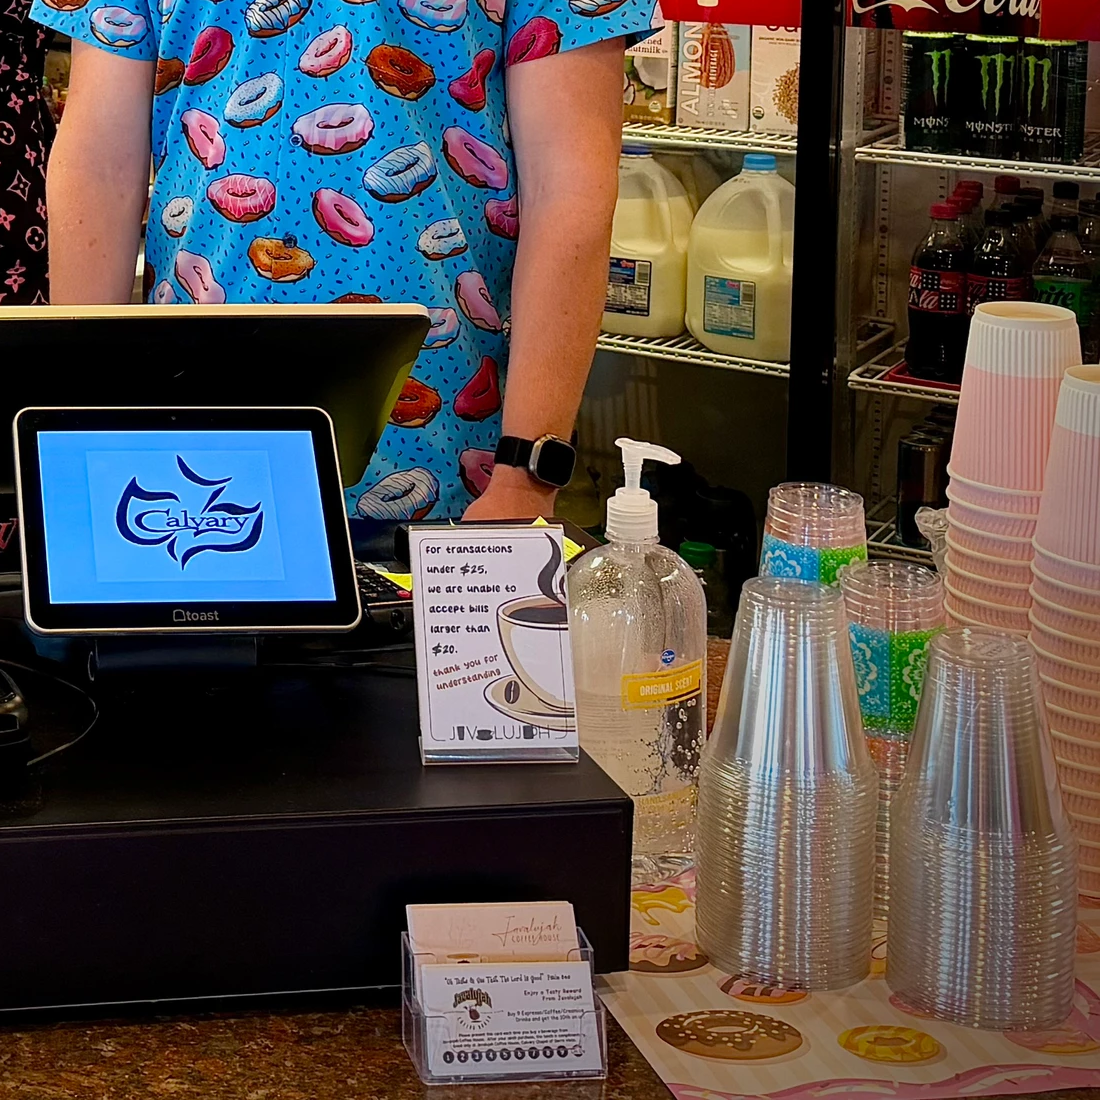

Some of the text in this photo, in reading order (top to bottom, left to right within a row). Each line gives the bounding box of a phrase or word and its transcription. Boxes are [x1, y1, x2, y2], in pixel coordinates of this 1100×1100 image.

[134, 507, 250, 535] Calvary
[446, 545, 513, 554] transactions
[426, 565, 456, 574] under
[427, 584, 517, 593] we are unable to
[186, 609, 220, 622] toast
[429, 604, 489, 614] accept bills
[430, 624, 491, 634] larger than
[432, 642, 458, 657] $20.
[433, 664, 461, 677] thank
[463, 658, 481, 670] you
[436, 668, 501, 691] understanding
[640, 675, 693, 696] ORIGINAL SCENT
[492, 915, 563, 947] Javalujah
[453, 987, 493, 1009] Javalujah
